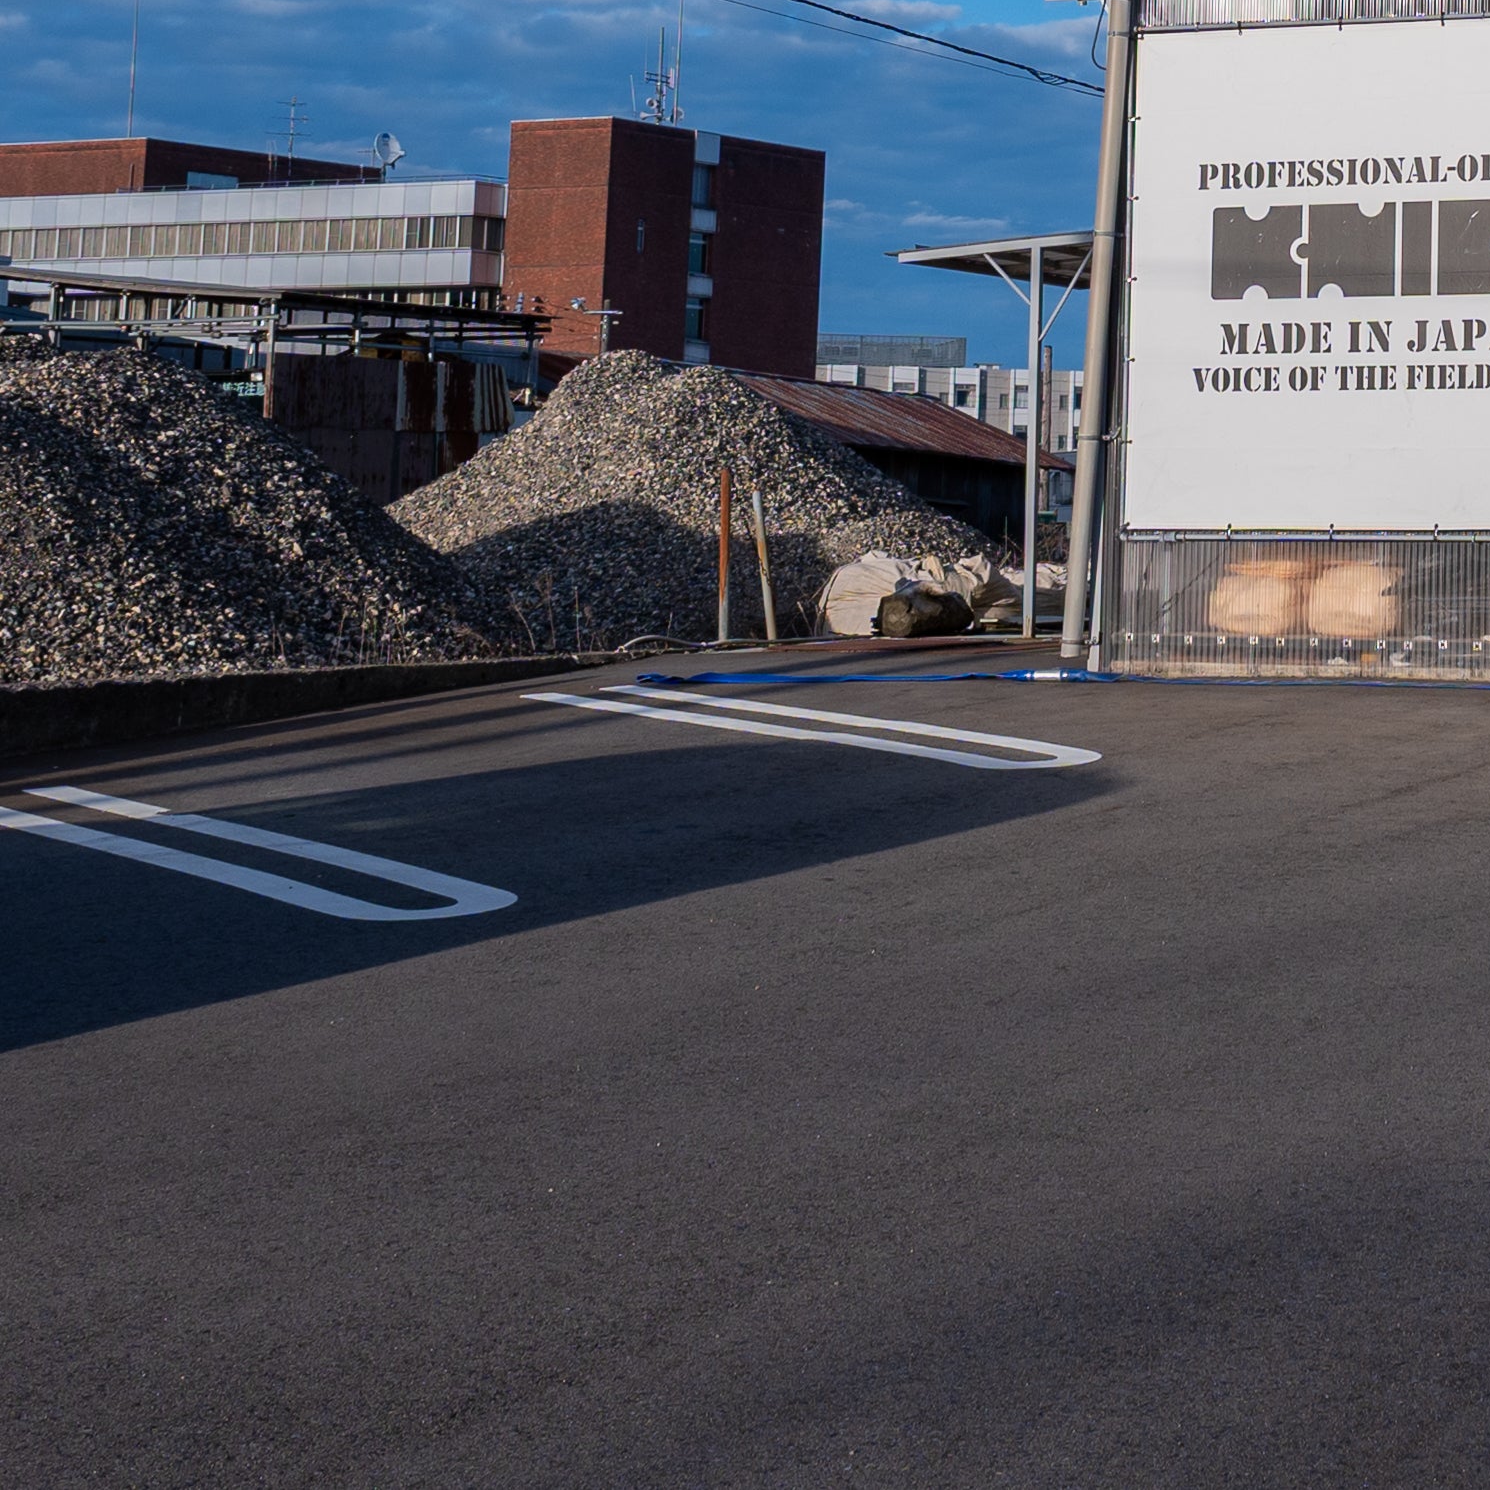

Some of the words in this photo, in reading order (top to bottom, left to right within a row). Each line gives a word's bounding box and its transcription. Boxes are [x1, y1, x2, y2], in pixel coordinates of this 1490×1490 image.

[1218, 321, 1333, 356] MADE
[1347, 320, 1393, 354] IN
[1192, 365, 1281, 394] VOICE
[1288, 365, 1328, 392] OF
[1334, 364, 1397, 391] THE
